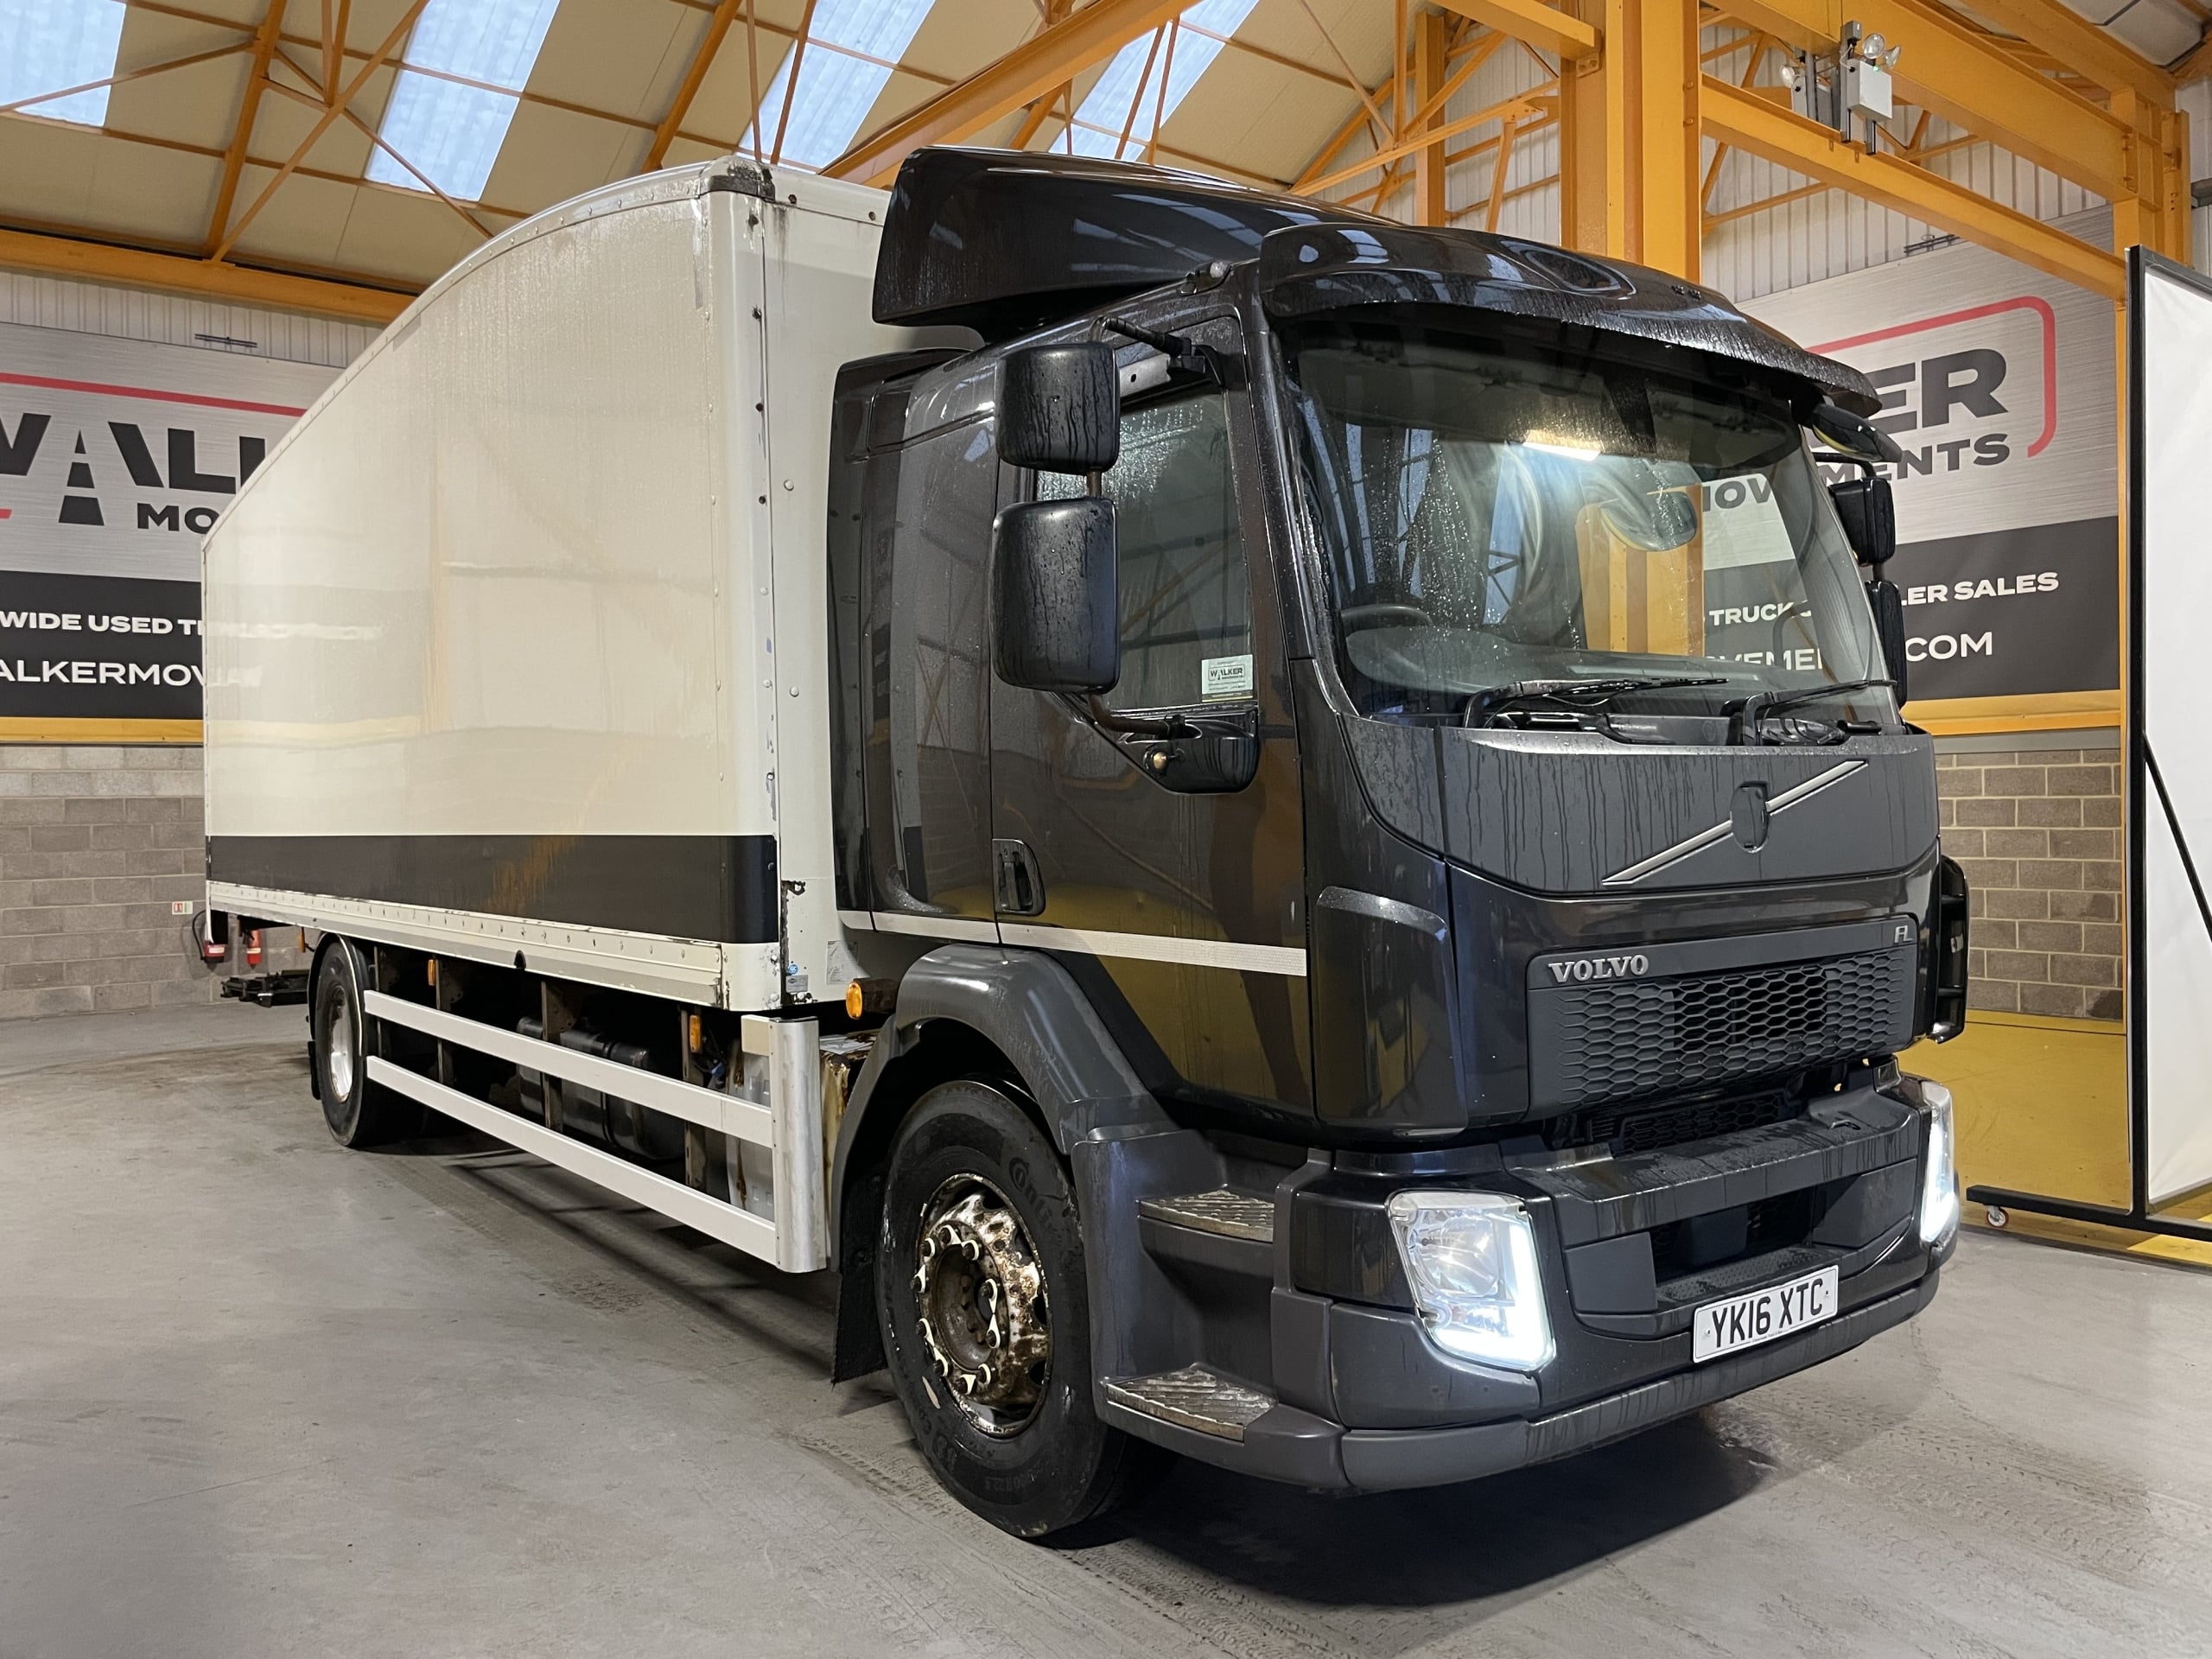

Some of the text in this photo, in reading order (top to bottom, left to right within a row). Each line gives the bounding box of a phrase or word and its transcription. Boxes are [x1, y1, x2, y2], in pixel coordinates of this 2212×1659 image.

[1954, 572, 2059, 601] SALES
[88, 614, 174, 634] USED
[1210, 667, 1243, 680] WALKER
[1548, 954, 1649, 983] VOLVO
[1712, 1278, 1823, 1348] YK16 XTC
